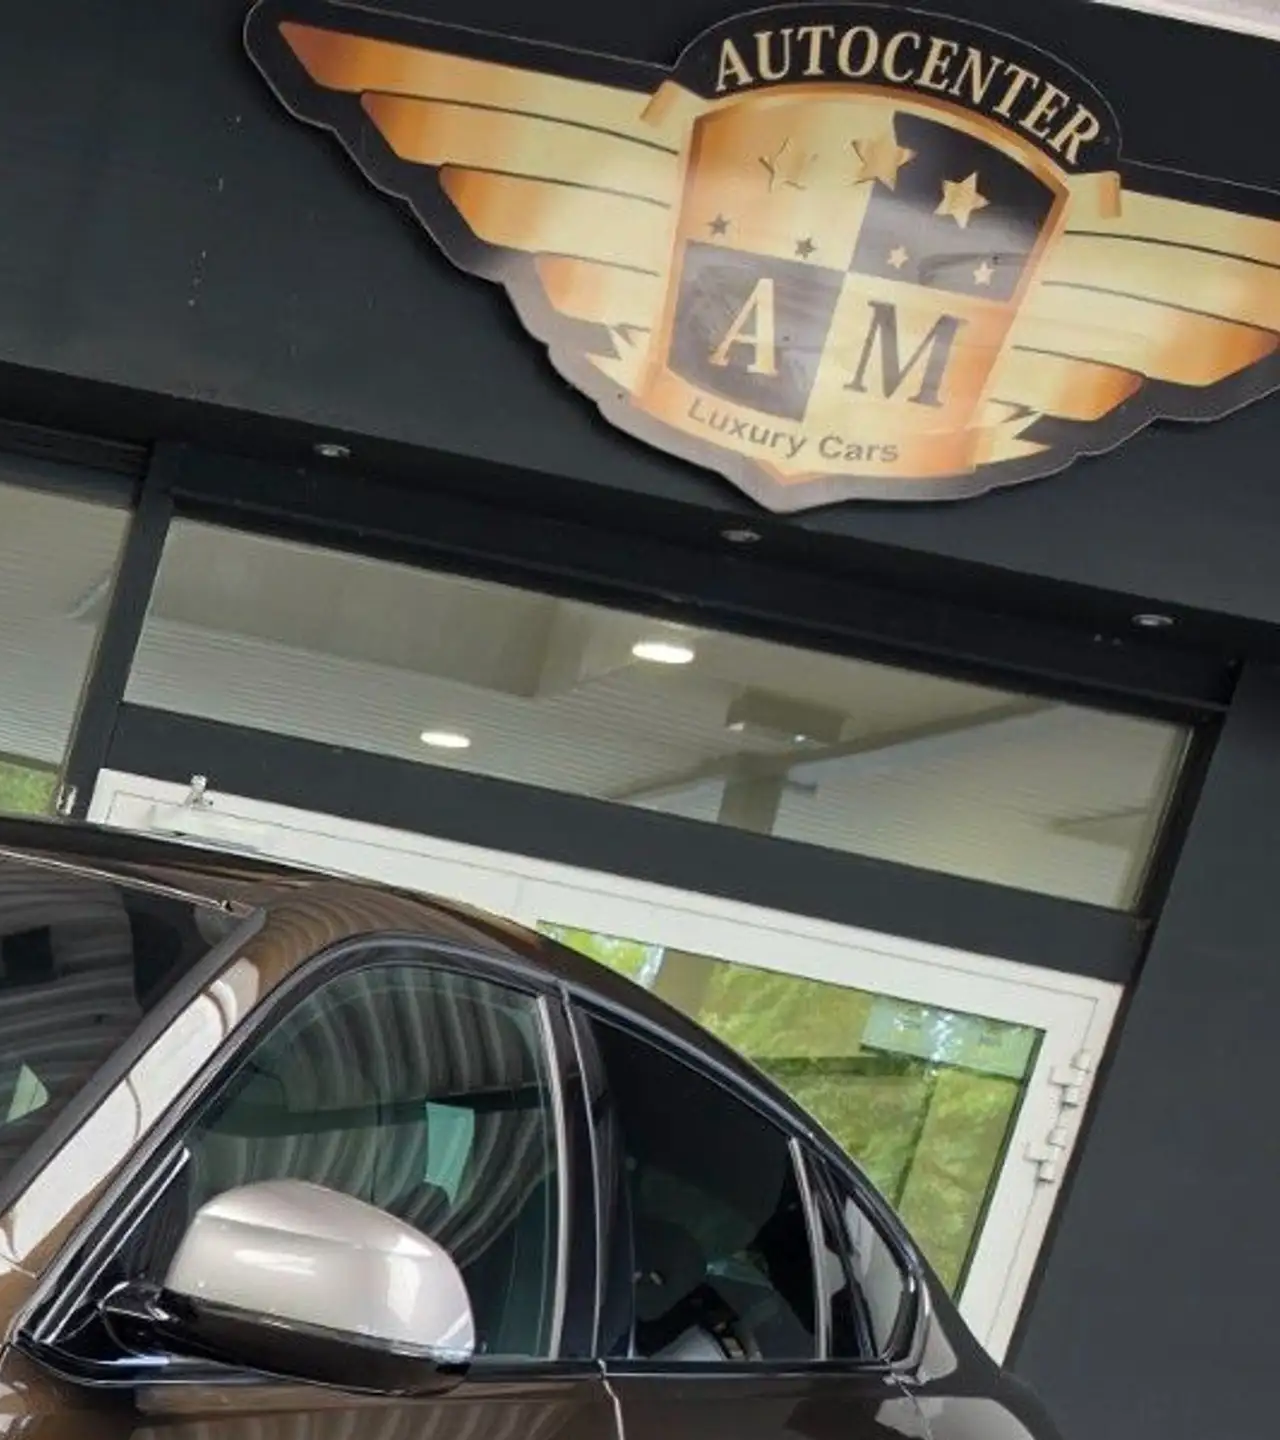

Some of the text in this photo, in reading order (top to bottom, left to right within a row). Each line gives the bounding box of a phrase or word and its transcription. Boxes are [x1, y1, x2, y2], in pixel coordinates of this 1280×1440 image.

[715, 25, 1100, 165] AUTOCENTER
[709, 277, 968, 406] A M
[687, 397, 900, 463] Luxury Cars
